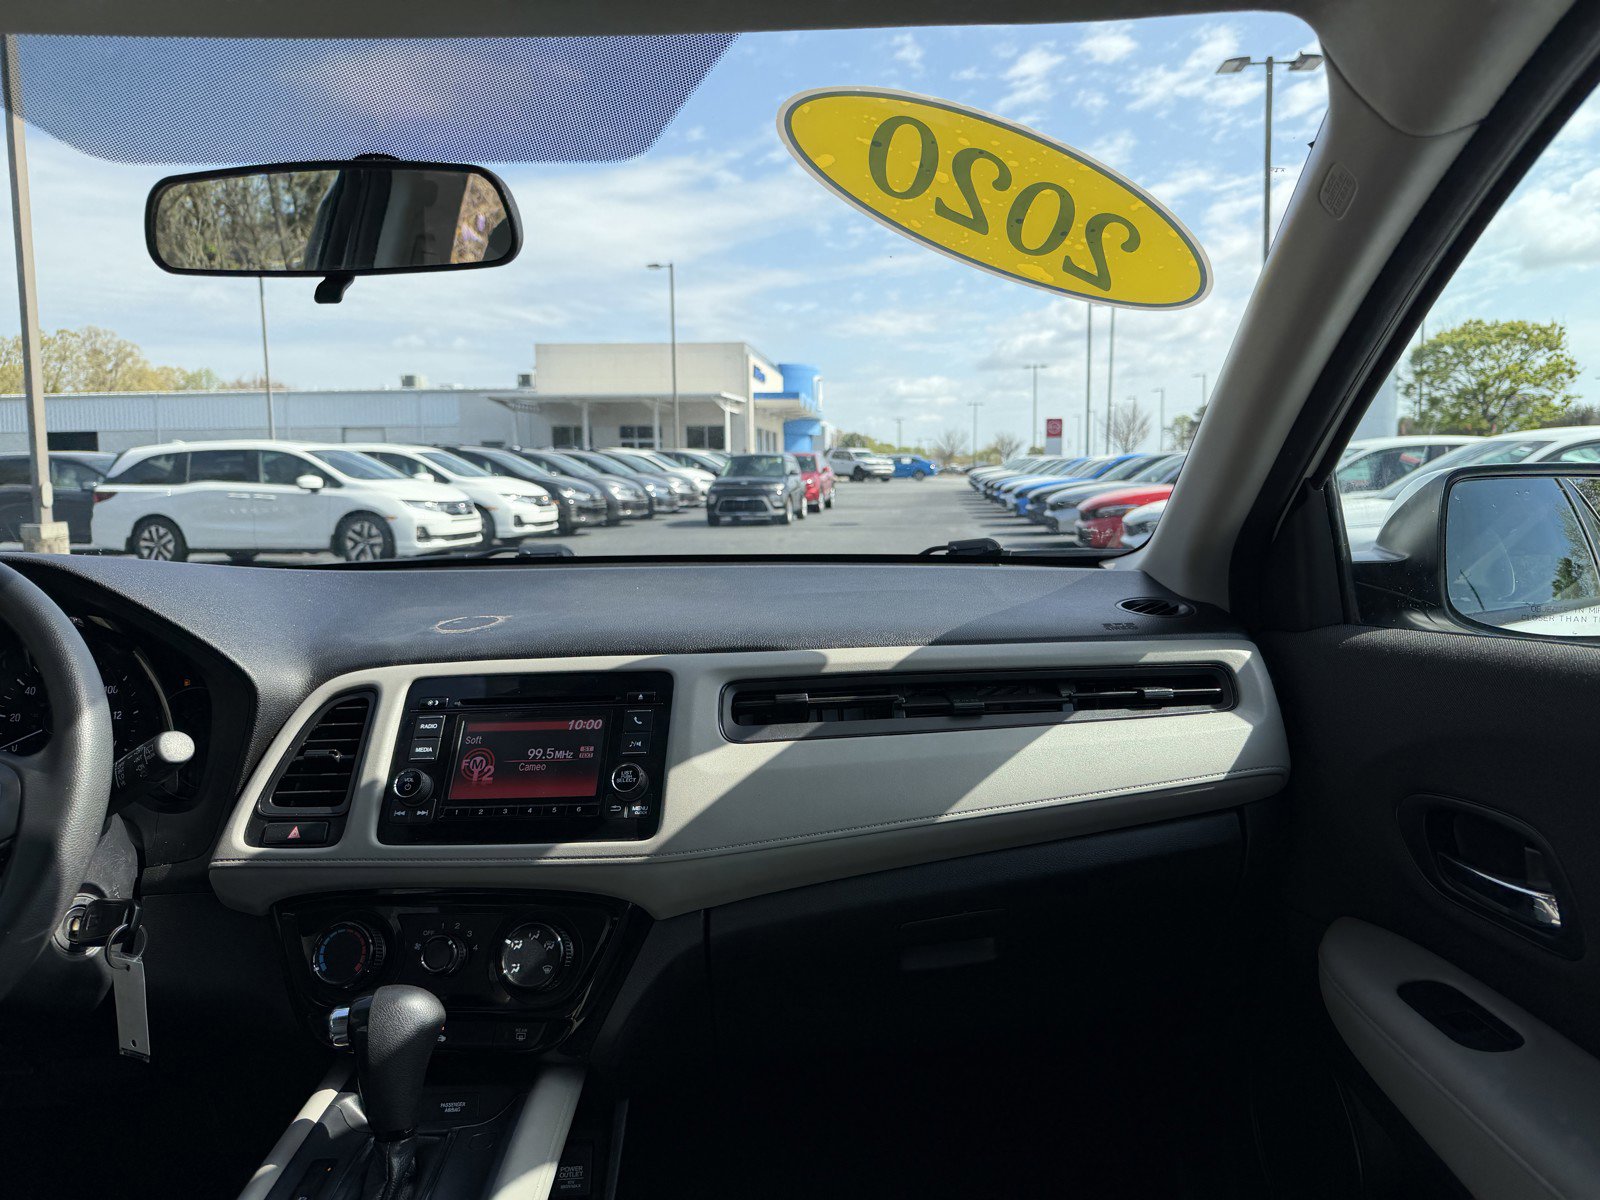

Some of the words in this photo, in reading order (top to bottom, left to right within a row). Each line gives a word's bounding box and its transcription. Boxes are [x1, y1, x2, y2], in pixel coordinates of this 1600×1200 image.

[24, 686, 36, 696] 40
[9, 712, 21, 722] 20
[568, 718, 603, 731] 10:00
[465, 735, 482, 745] Soft
[518, 762, 547, 772] Cameo
